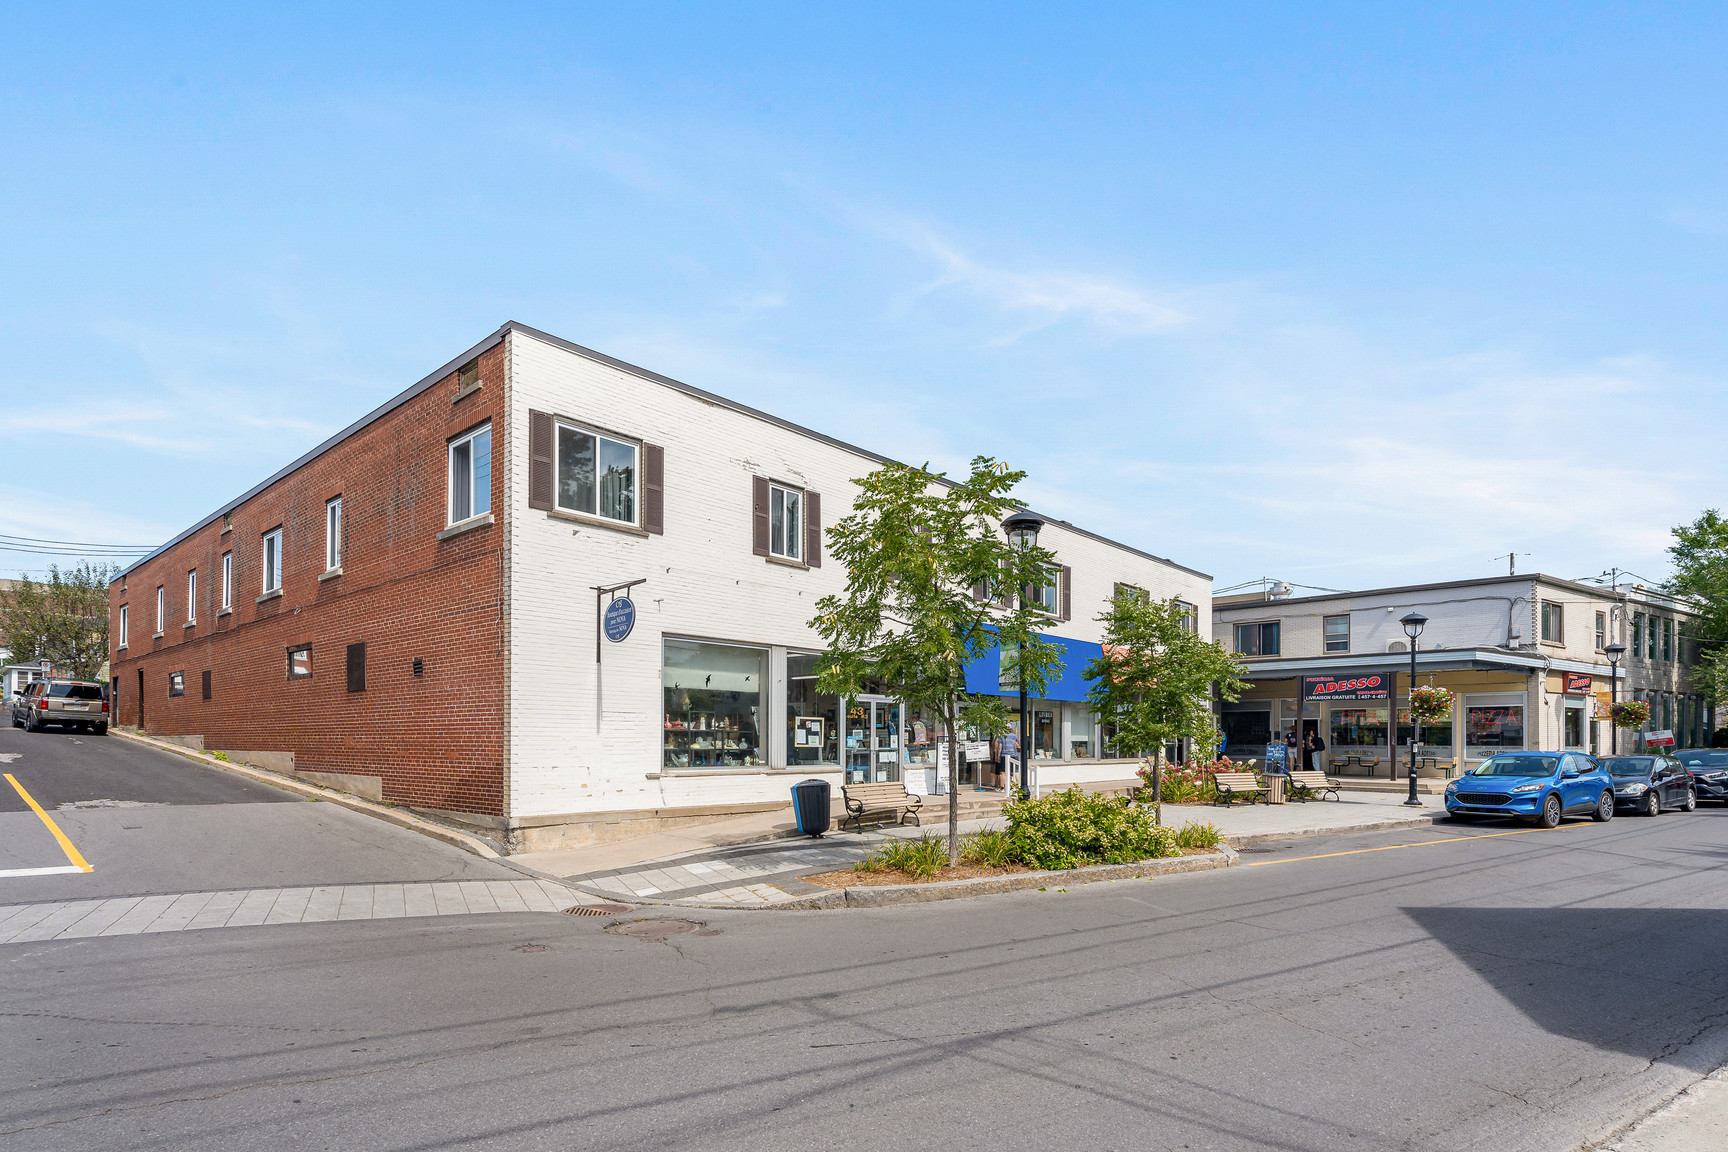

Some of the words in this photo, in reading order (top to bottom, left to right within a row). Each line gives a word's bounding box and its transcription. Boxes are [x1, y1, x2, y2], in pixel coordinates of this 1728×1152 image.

[1313, 676, 1381, 695] ADESSO
[1570, 677, 1590, 688] ADESSO
[850, 706, 864, 716] 43
[1340, 711, 1380, 726] PITA
[1471, 709, 1518, 725] PIZZA
